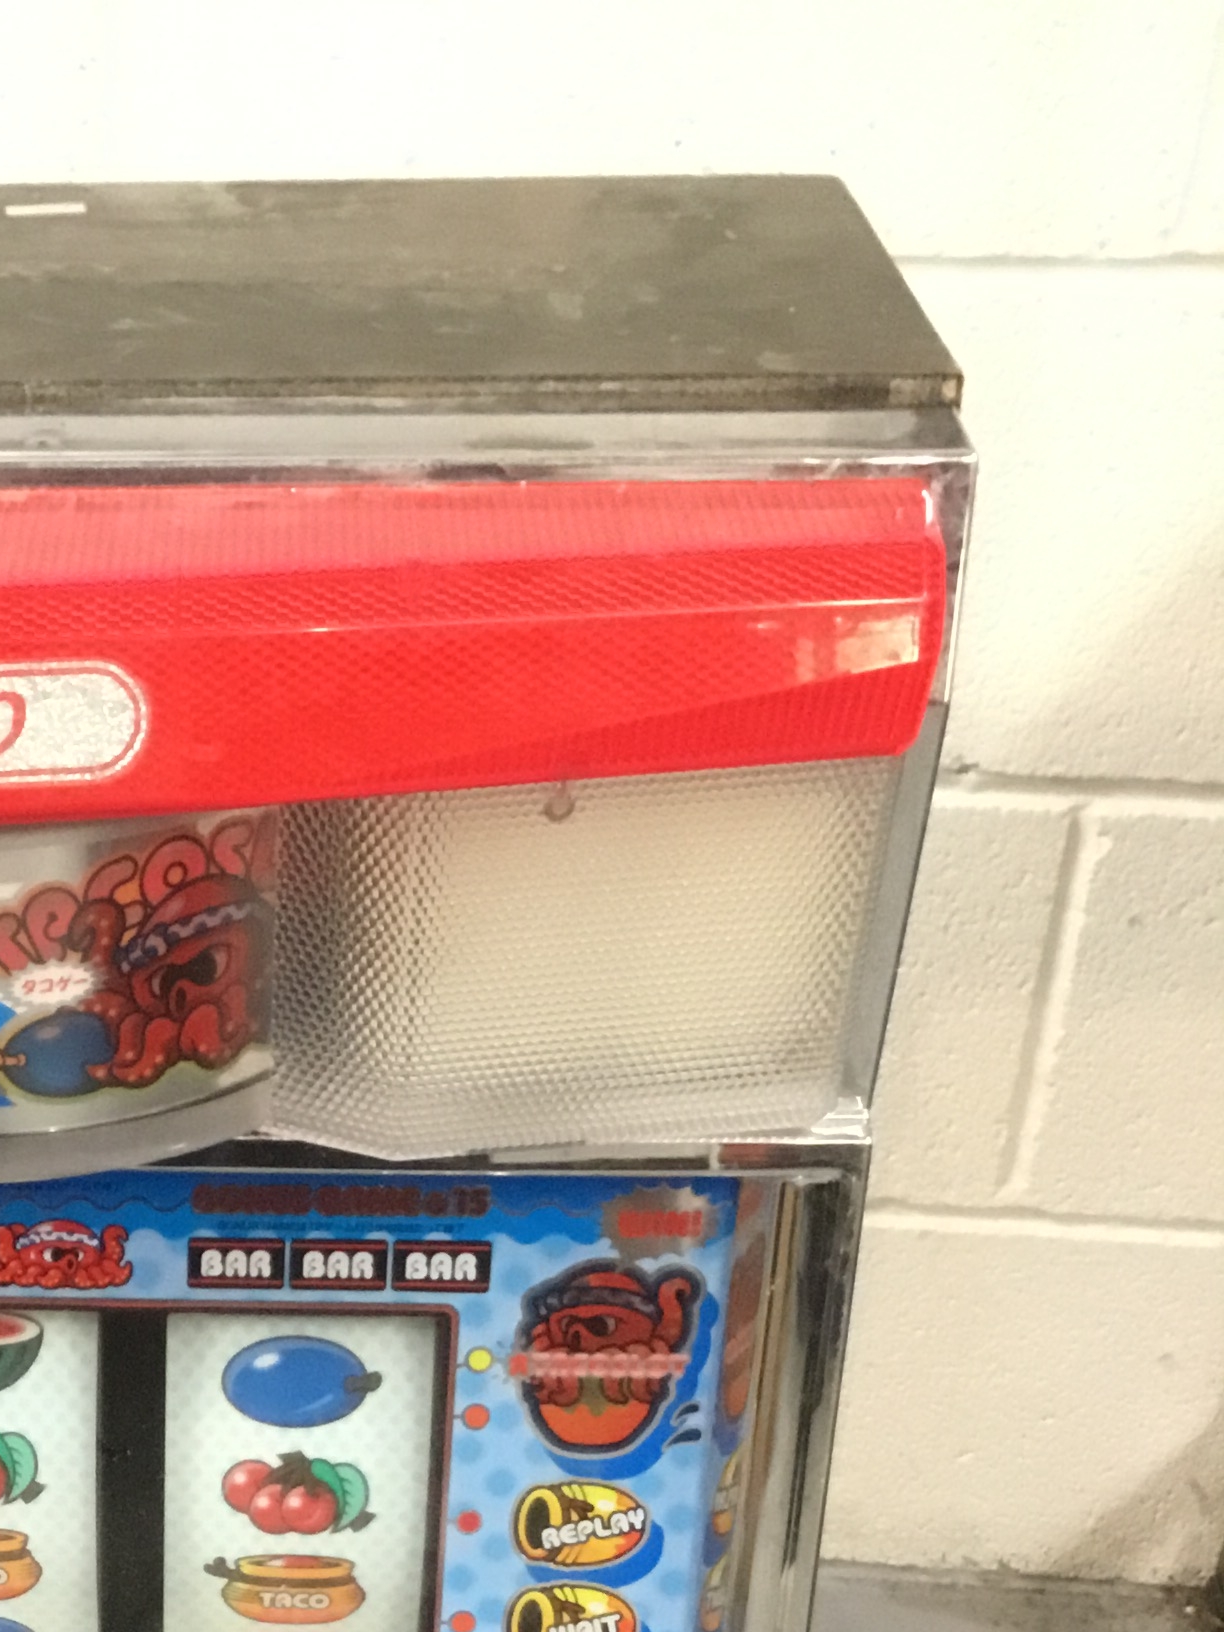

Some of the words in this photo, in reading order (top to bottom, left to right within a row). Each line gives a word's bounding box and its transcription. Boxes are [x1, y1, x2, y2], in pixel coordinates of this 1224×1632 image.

[200, 1248, 271, 1278] BAR
[302, 1250, 374, 1280] BAR
[405, 1252, 477, 1281] BAR
[541, 1508, 646, 1550] REPLAY
[258, 1590, 331, 1611] TACO
